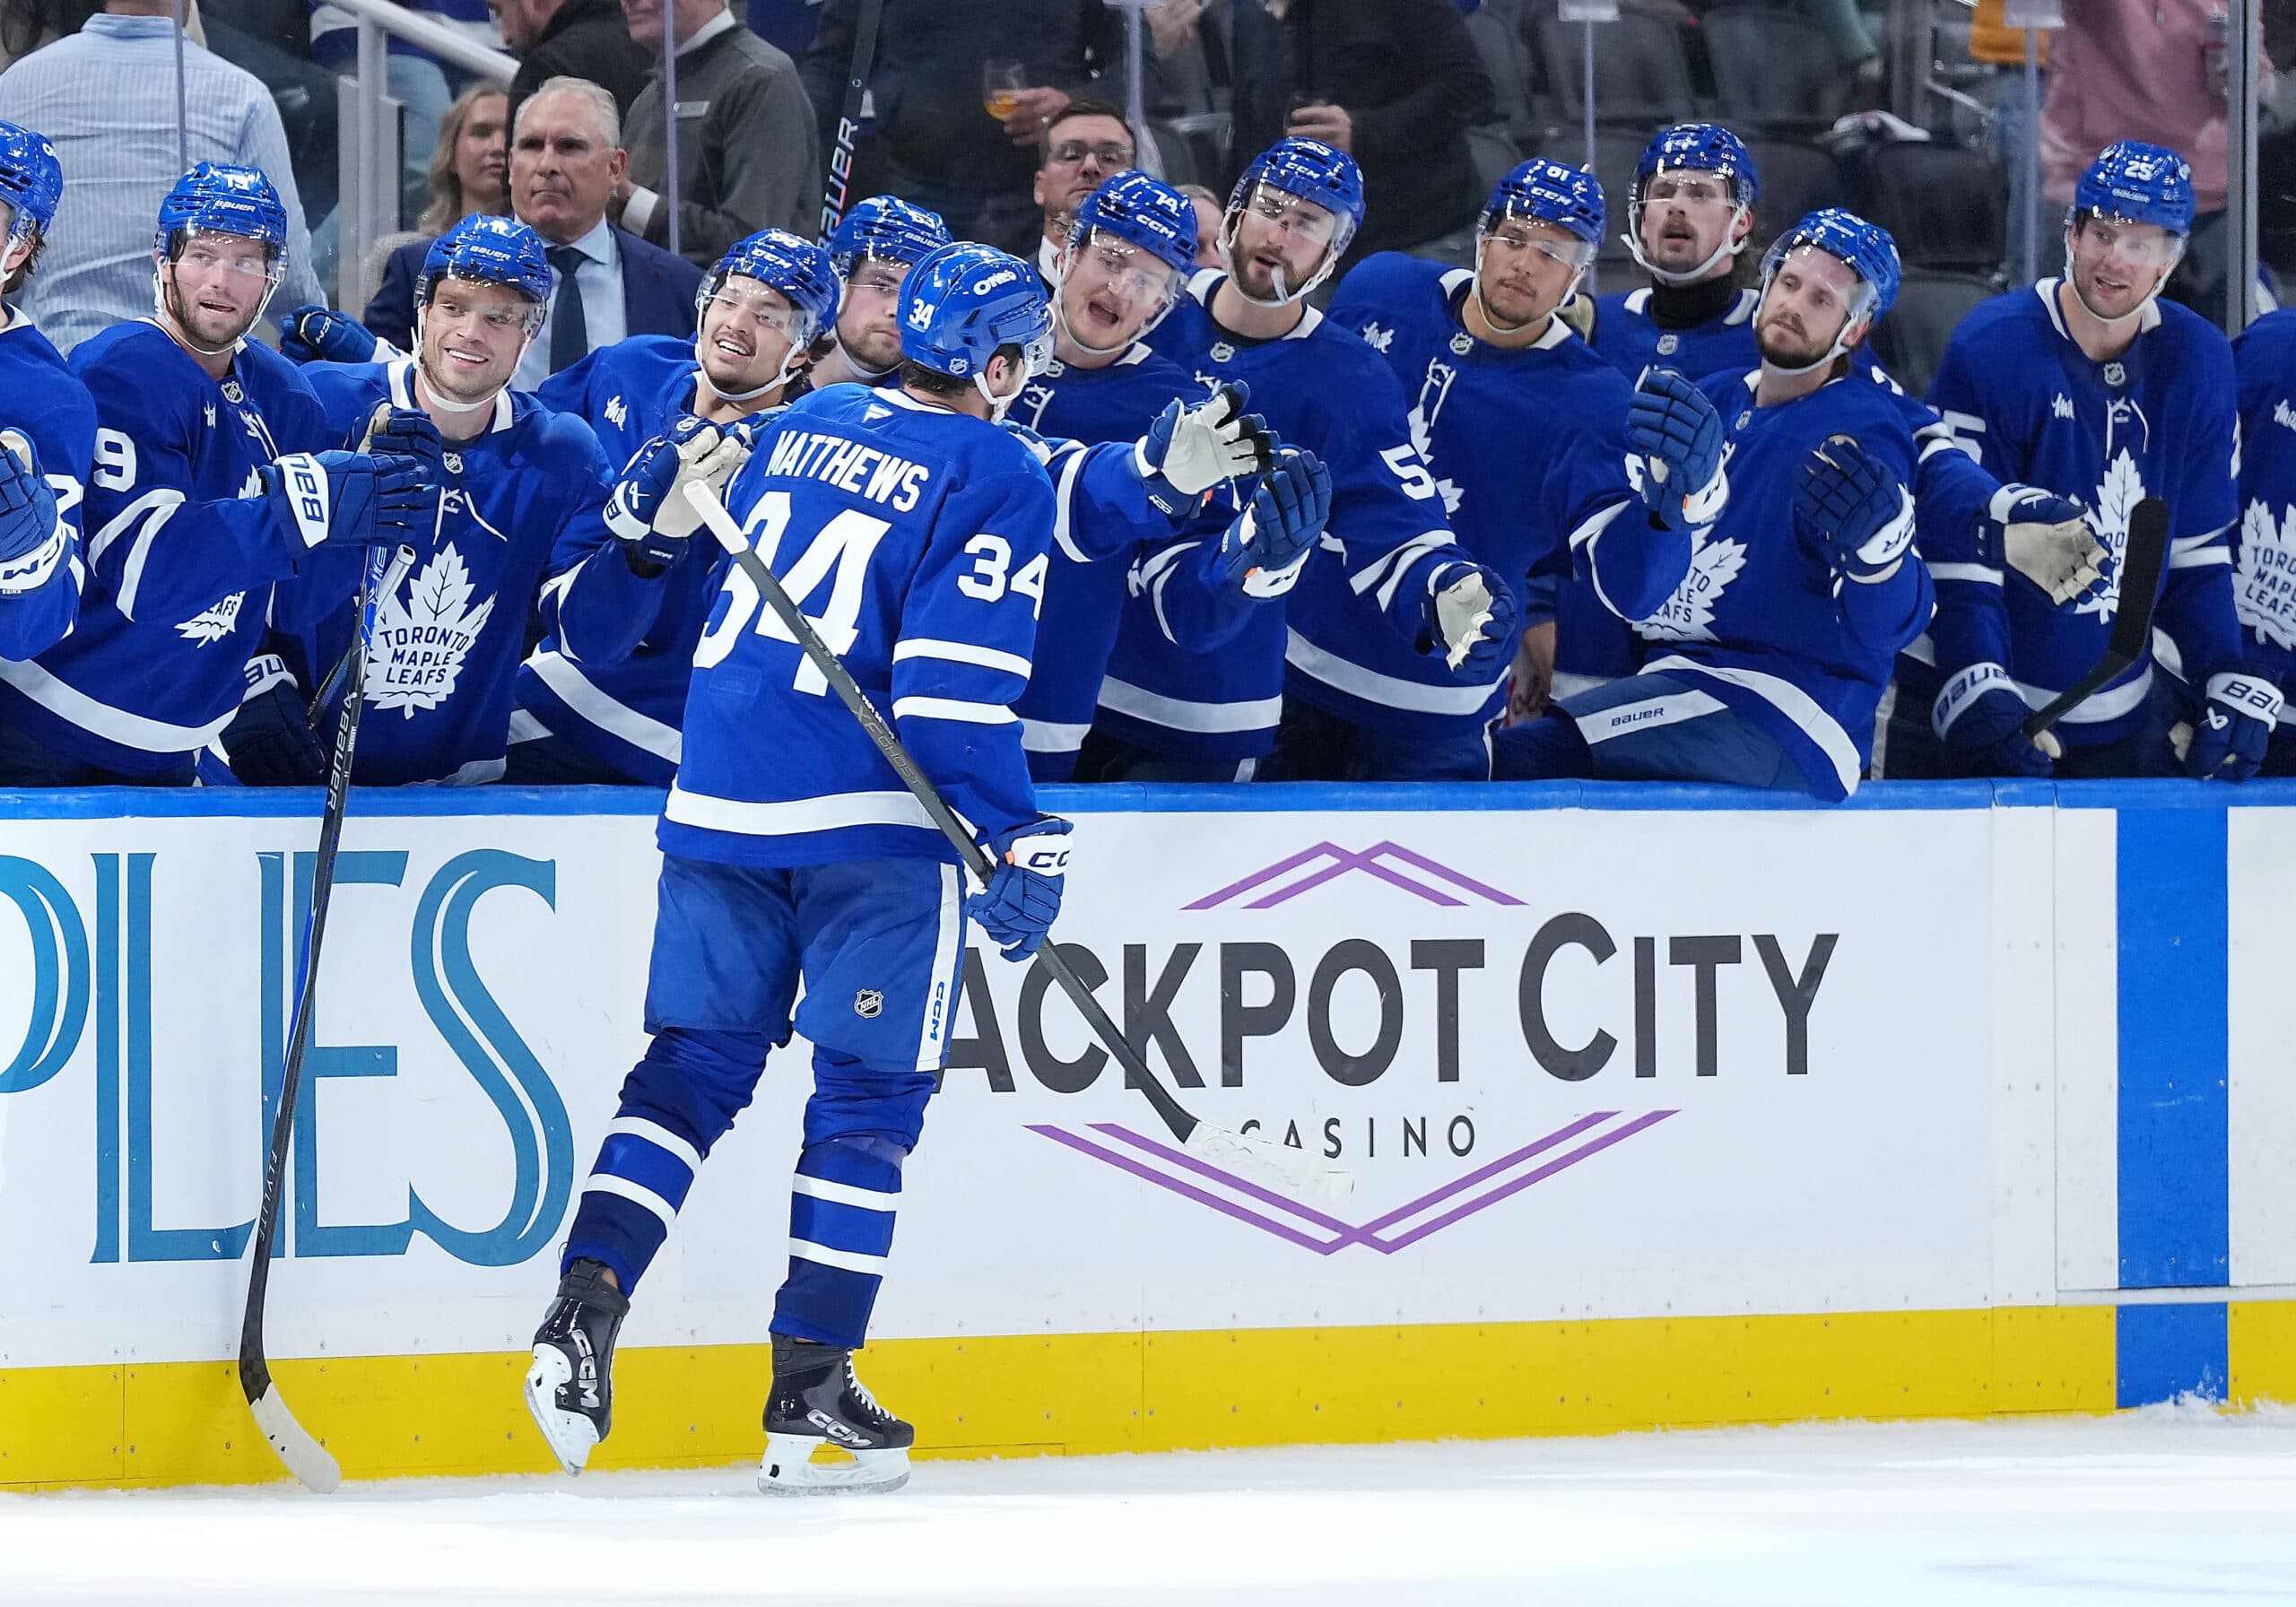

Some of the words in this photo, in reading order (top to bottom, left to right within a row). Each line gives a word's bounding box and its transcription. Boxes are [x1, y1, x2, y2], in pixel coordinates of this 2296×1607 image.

[1285, 161, 1321, 180] CCM
[2124, 160, 2156, 182] 25
[1530, 186, 1573, 206] CCM
[1135, 213, 1178, 239] CCM
[751, 248, 794, 269] CCM
[909, 297, 935, 330] 34
[93, 427, 137, 492] 9
[764, 430, 929, 513] MATTHEWS
[1378, 443, 1436, 500] 5
[957, 534, 1049, 621] 34
[2251, 543, 2296, 578] TORO
[692, 490, 893, 697] 34
[2255, 565, 2296, 604] MAP
[1655, 601, 1692, 623] AFS
[379, 626, 470, 651] TORONTO
[391, 647, 454, 666] MAPLE
[386, 668, 447, 686] LEAFS
[878, 735, 922, 788] GHOST
[1028, 852, 1071, 868] CC
[929, 981, 945, 1041] CCM
[930, 938, 1485, 1094] ACKPOT
[1518, 911, 1840, 1082] CITY
[258, 1149, 278, 1242] FLYLITE
[571, 1328, 601, 1409] CCM
[806, 1409, 874, 1446] CCM
